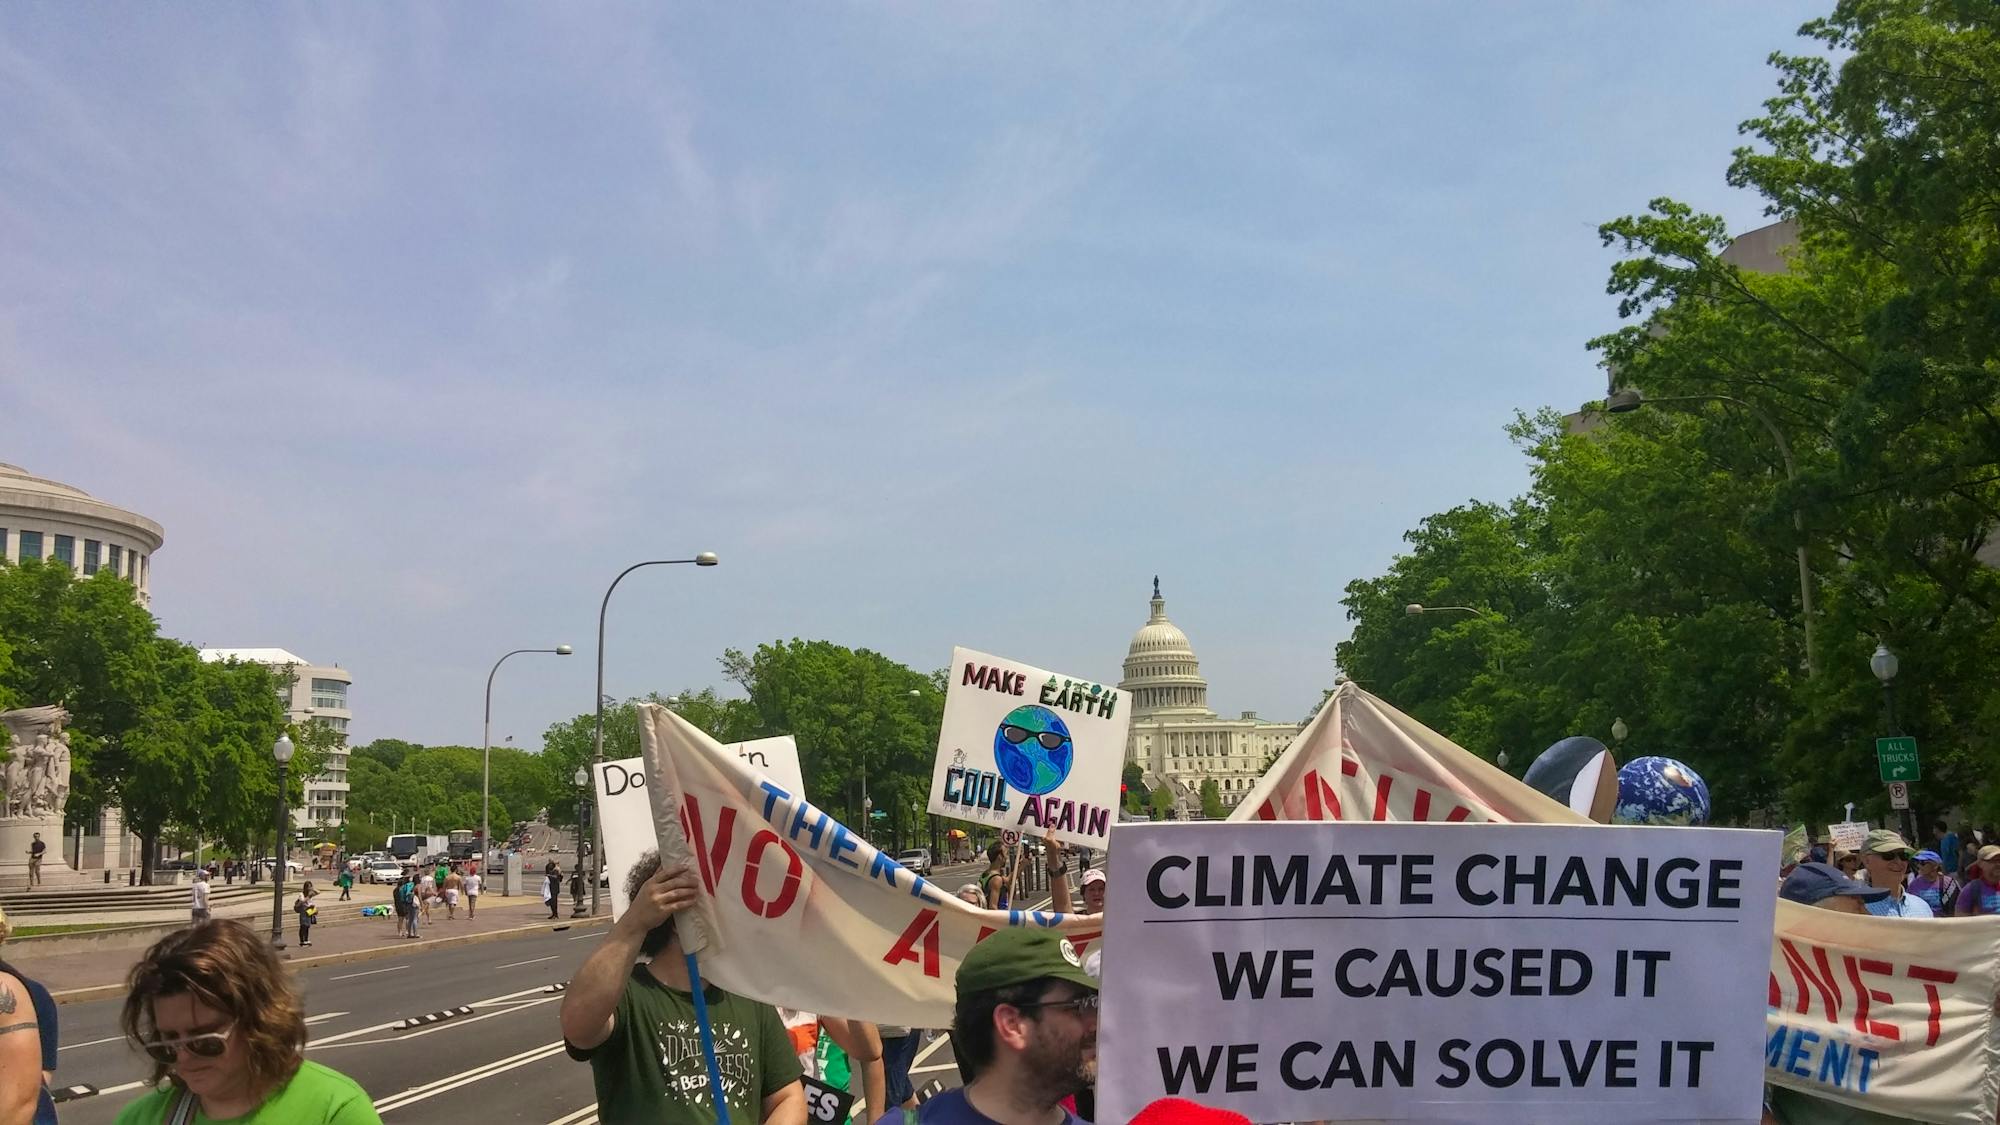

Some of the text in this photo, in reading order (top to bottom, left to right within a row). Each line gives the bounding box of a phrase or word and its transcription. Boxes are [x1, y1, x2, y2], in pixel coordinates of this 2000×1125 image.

[962, 662, 1117, 720] MAKE EARTH
[1881, 752, 1916, 763] TRUCKS
[1887, 742, 1905, 752] ALL
[943, 766, 1110, 838] COOL AGAIN
[1146, 853, 1743, 909] CLIMATE CHANGE
[1212, 947, 1671, 1001] WE CAUSED IT
[665, 1034, 751, 1085] DAIL RESS
[1157, 1038, 1715, 1096] WE CAN SOLVE IT
